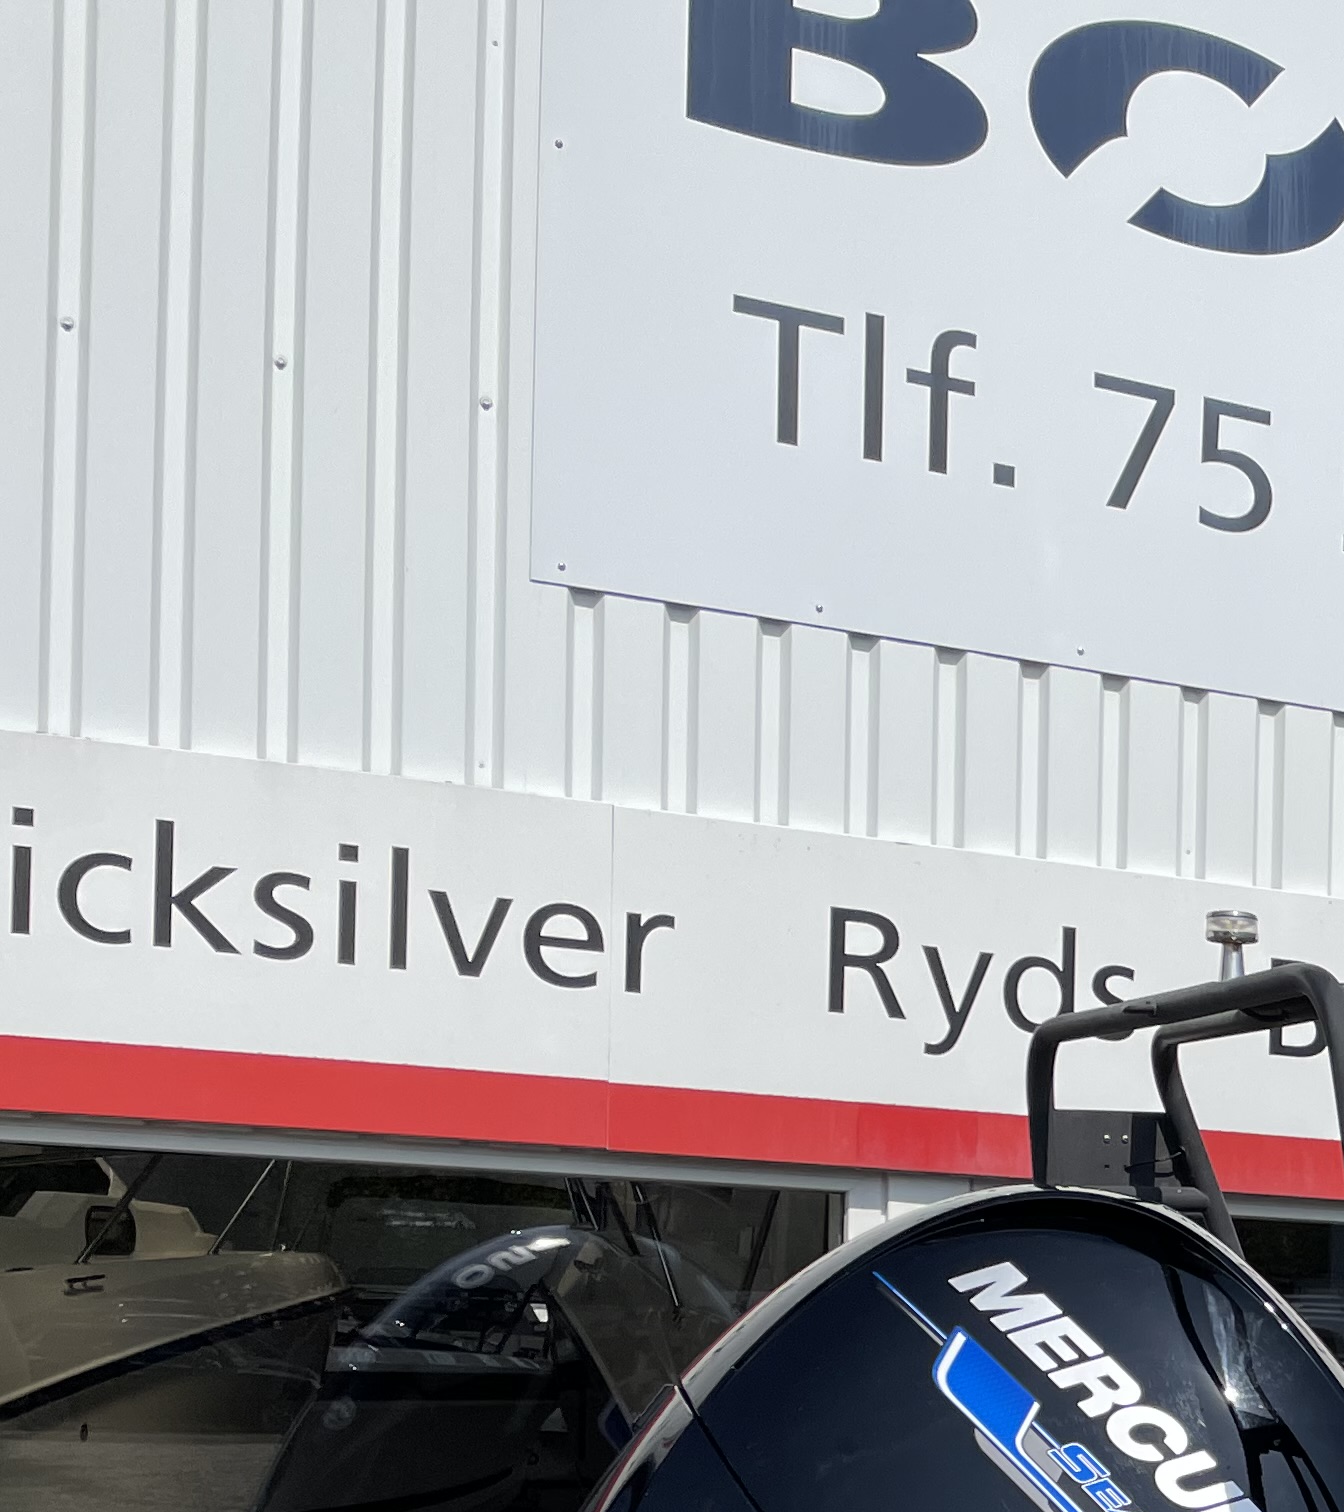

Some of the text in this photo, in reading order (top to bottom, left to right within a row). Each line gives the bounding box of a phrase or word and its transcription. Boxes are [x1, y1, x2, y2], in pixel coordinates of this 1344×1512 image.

[733, 293, 1016, 488] Tlf.
[1093, 371, 1273, 534] 75
[11, 806, 676, 995] icksilver
[827, 905, 1136, 1056] Ryds
